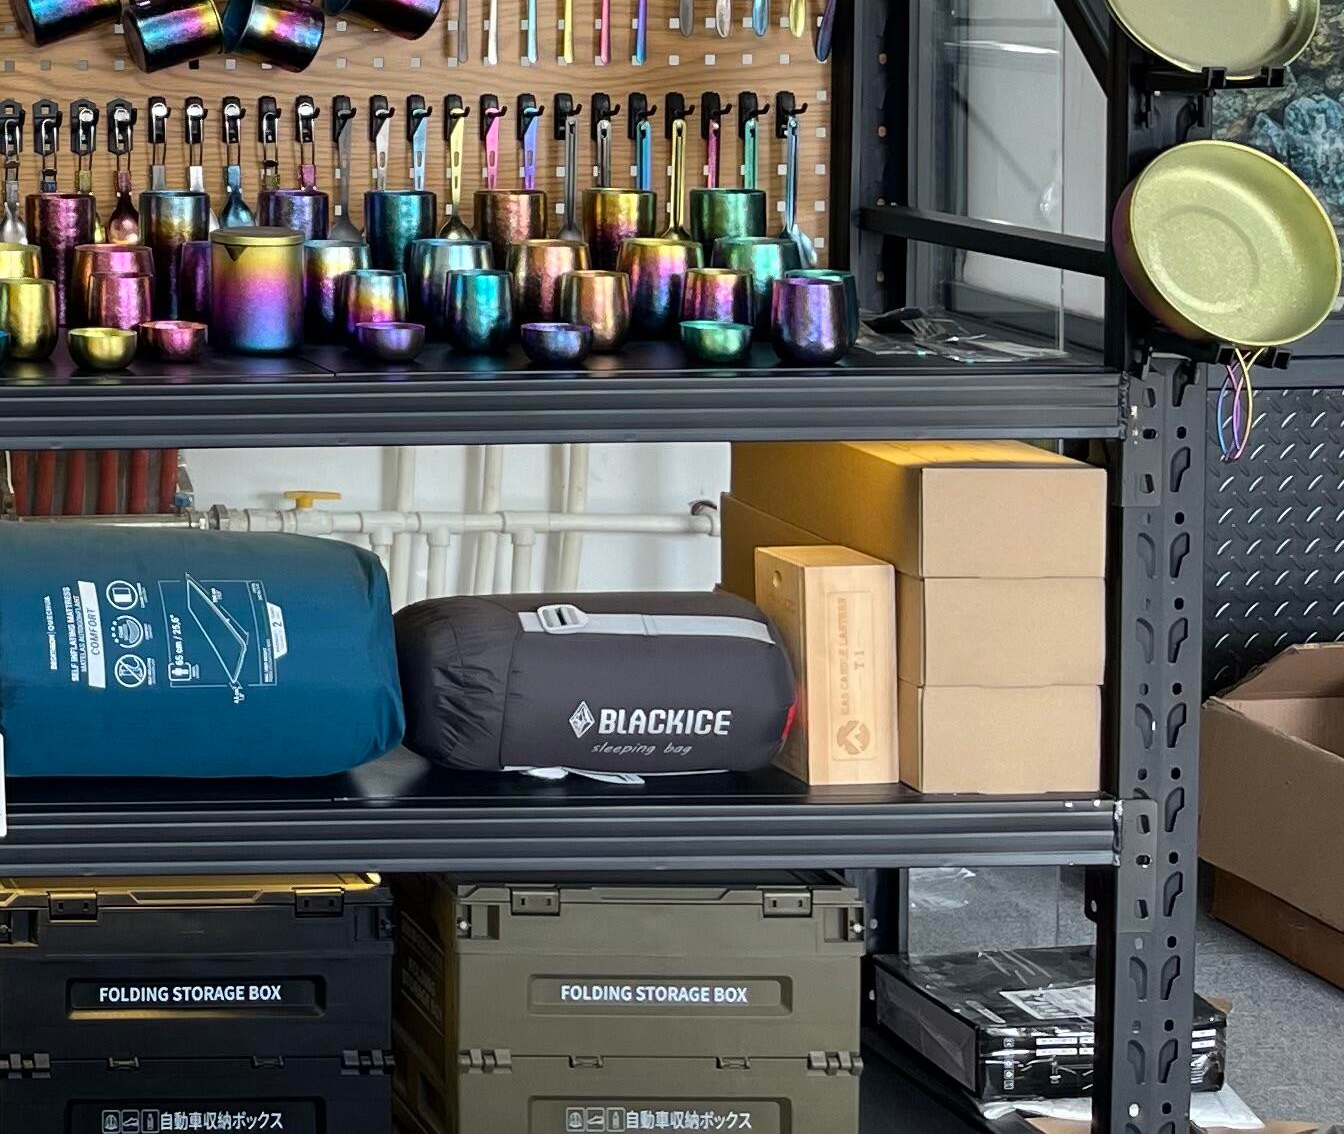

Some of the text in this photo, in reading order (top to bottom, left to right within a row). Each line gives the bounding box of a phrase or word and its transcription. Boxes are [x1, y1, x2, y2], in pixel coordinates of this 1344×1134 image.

[62, 586, 75, 623] MATTRESS
[86, 607, 101, 656] COMFORT
[598, 708, 732, 735] BLACKICE
[591, 741, 693, 756] sleeping bag
[99, 984, 282, 1003] FOLDING STORAGE BOX
[561, 985, 748, 1003] FOLDING STORAGE BOX
